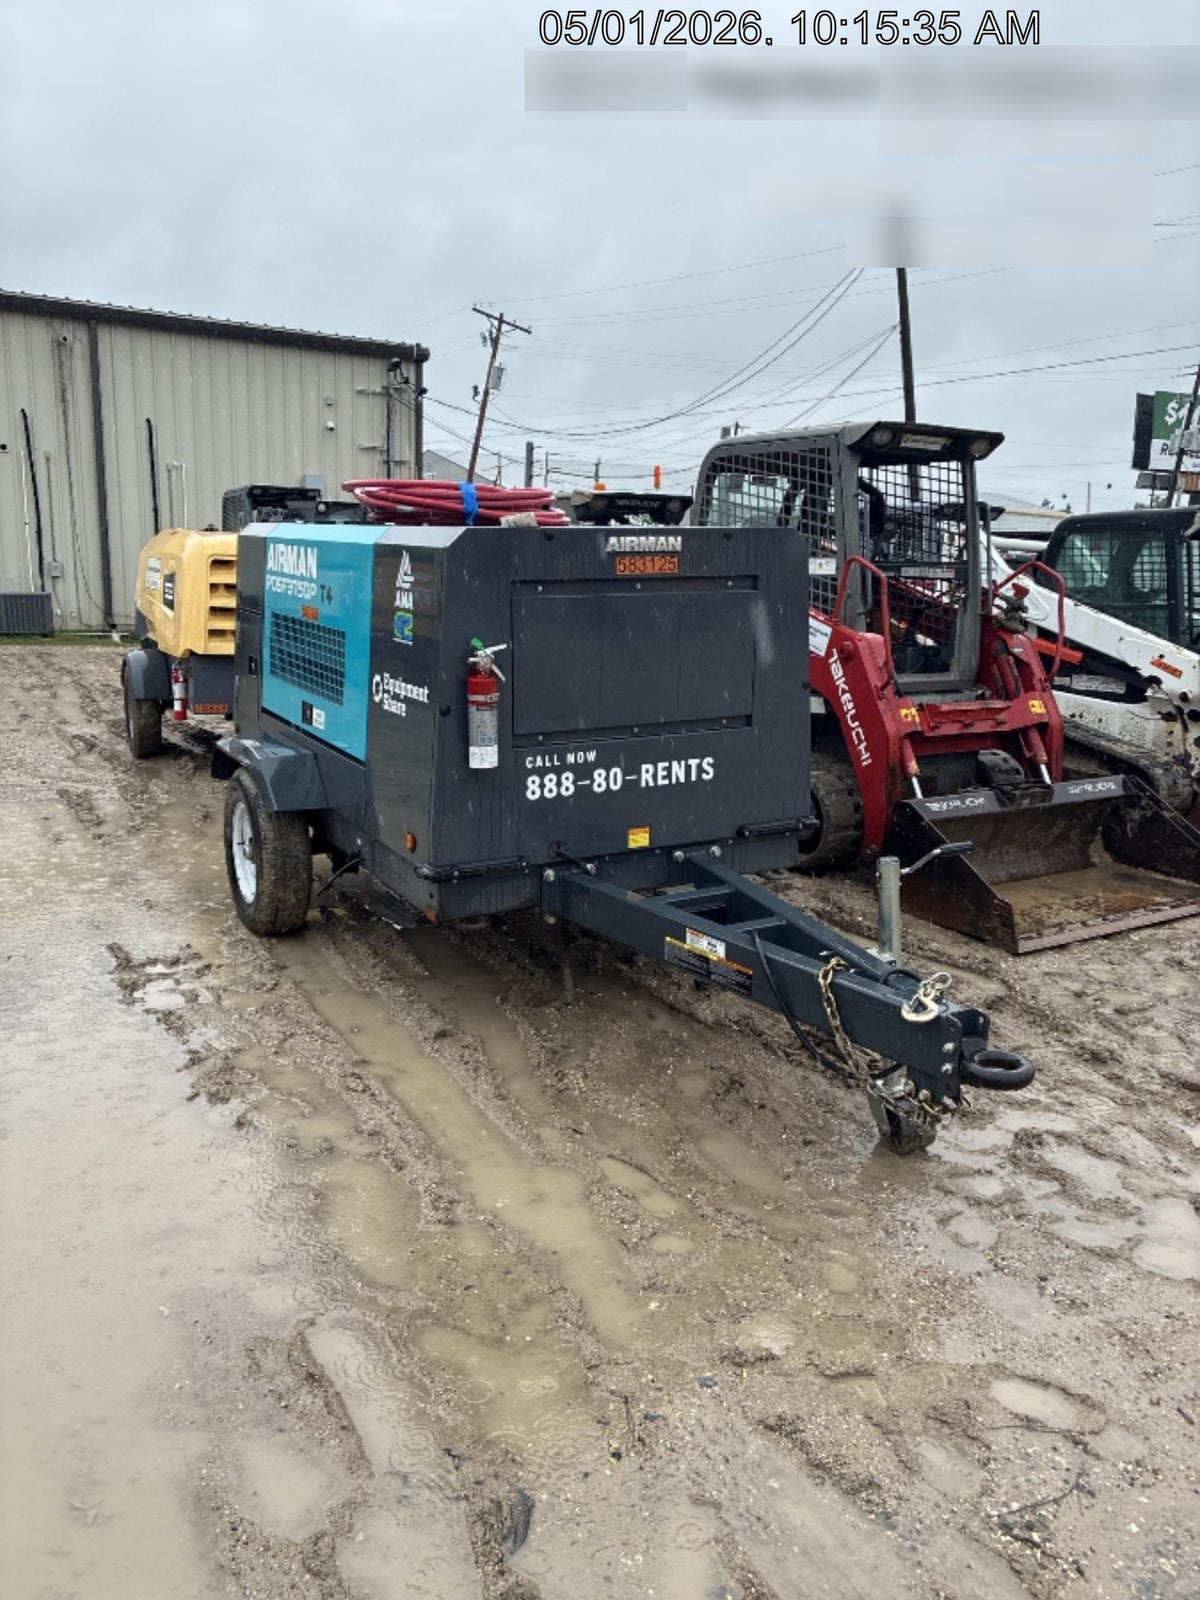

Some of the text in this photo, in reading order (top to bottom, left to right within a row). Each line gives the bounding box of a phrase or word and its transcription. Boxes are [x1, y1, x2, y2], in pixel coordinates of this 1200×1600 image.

[606, 536, 682, 552] AIRMAN
[267, 543, 317, 578] AIRMAN
[617, 556, 677, 573] 583125
[383, 672, 429, 703] Equipment
[383, 694, 406, 717] Share
[525, 750, 597, 769] CALL NOW
[525, 756, 715, 800] 888-80-RENTS
